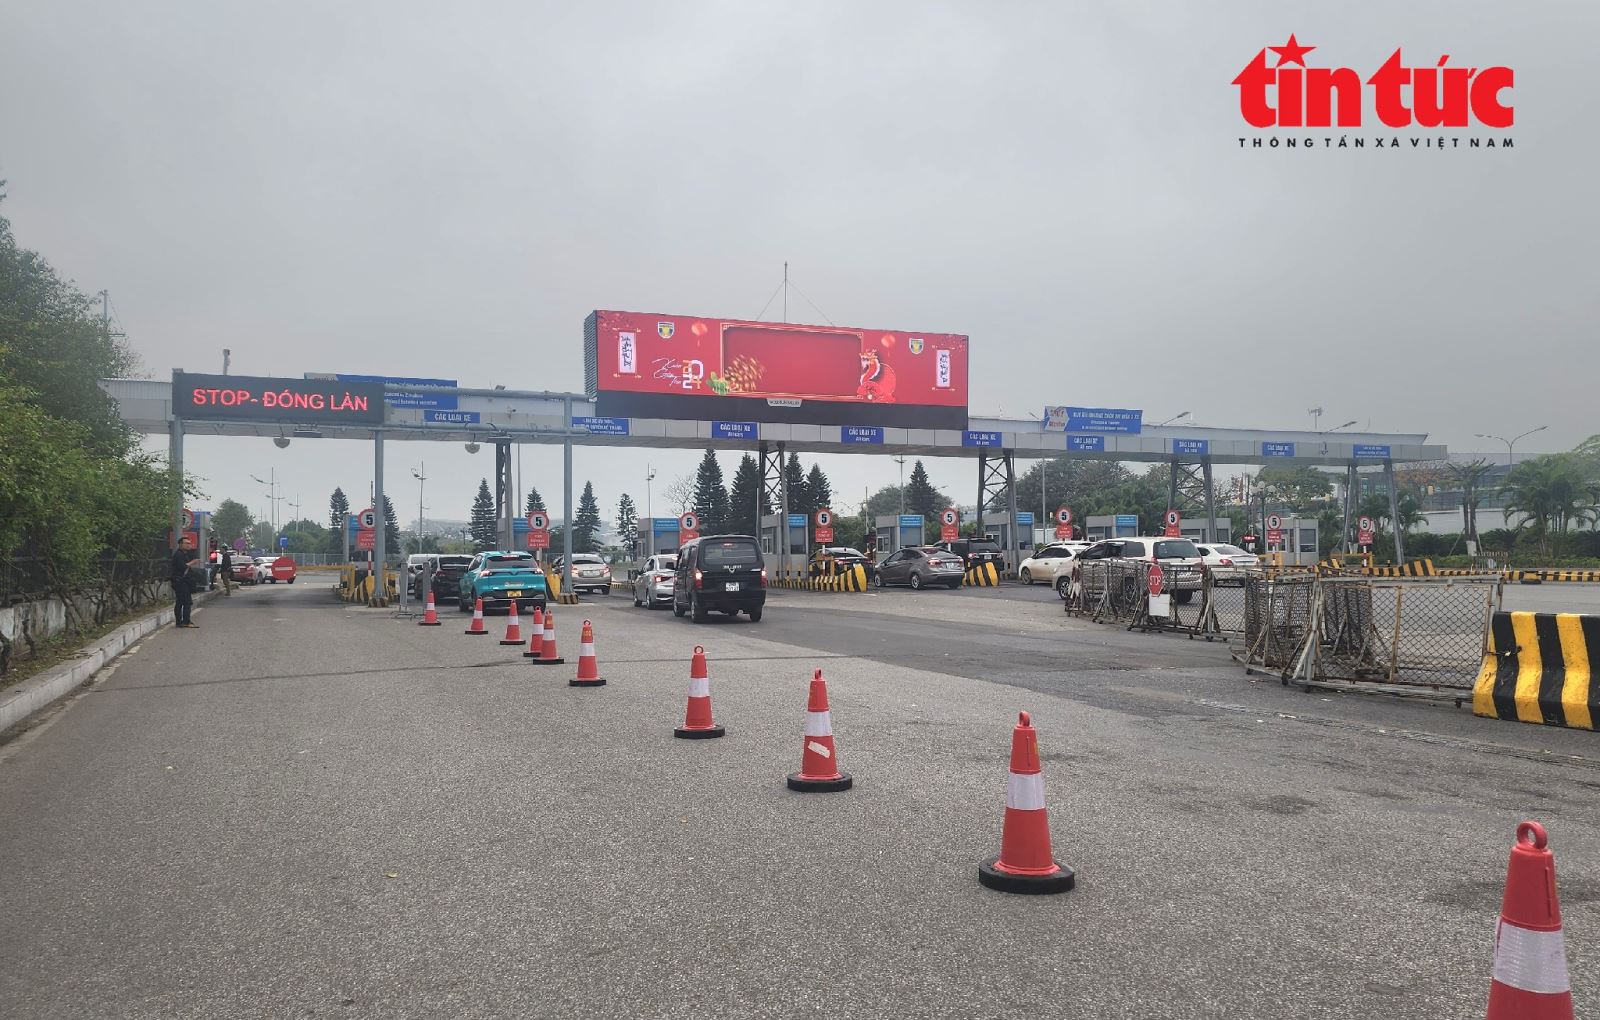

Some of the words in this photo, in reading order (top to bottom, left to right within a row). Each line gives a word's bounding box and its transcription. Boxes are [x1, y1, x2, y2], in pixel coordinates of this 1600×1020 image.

[262, 389, 325, 409] ĐÓNG
[330, 391, 368, 411] LÀN
[720, 422, 731, 431] CÁC
[744, 424, 751, 432] XE
[848, 427, 858, 436] CÁC
[871, 428, 877, 436] XE
[366, 514, 373, 526] 5
[821, 513, 827, 524] 5
[946, 513, 952, 523] 5
[1061, 511, 1067, 521] 5
[1170, 513, 1175, 523] 5
[535, 516, 542, 527] 5
[686, 517, 693, 528] 5
[1272, 517, 1277, 527] 5
[1362, 520, 1367, 529] 5
[1150, 575, 1161, 586] STOP
